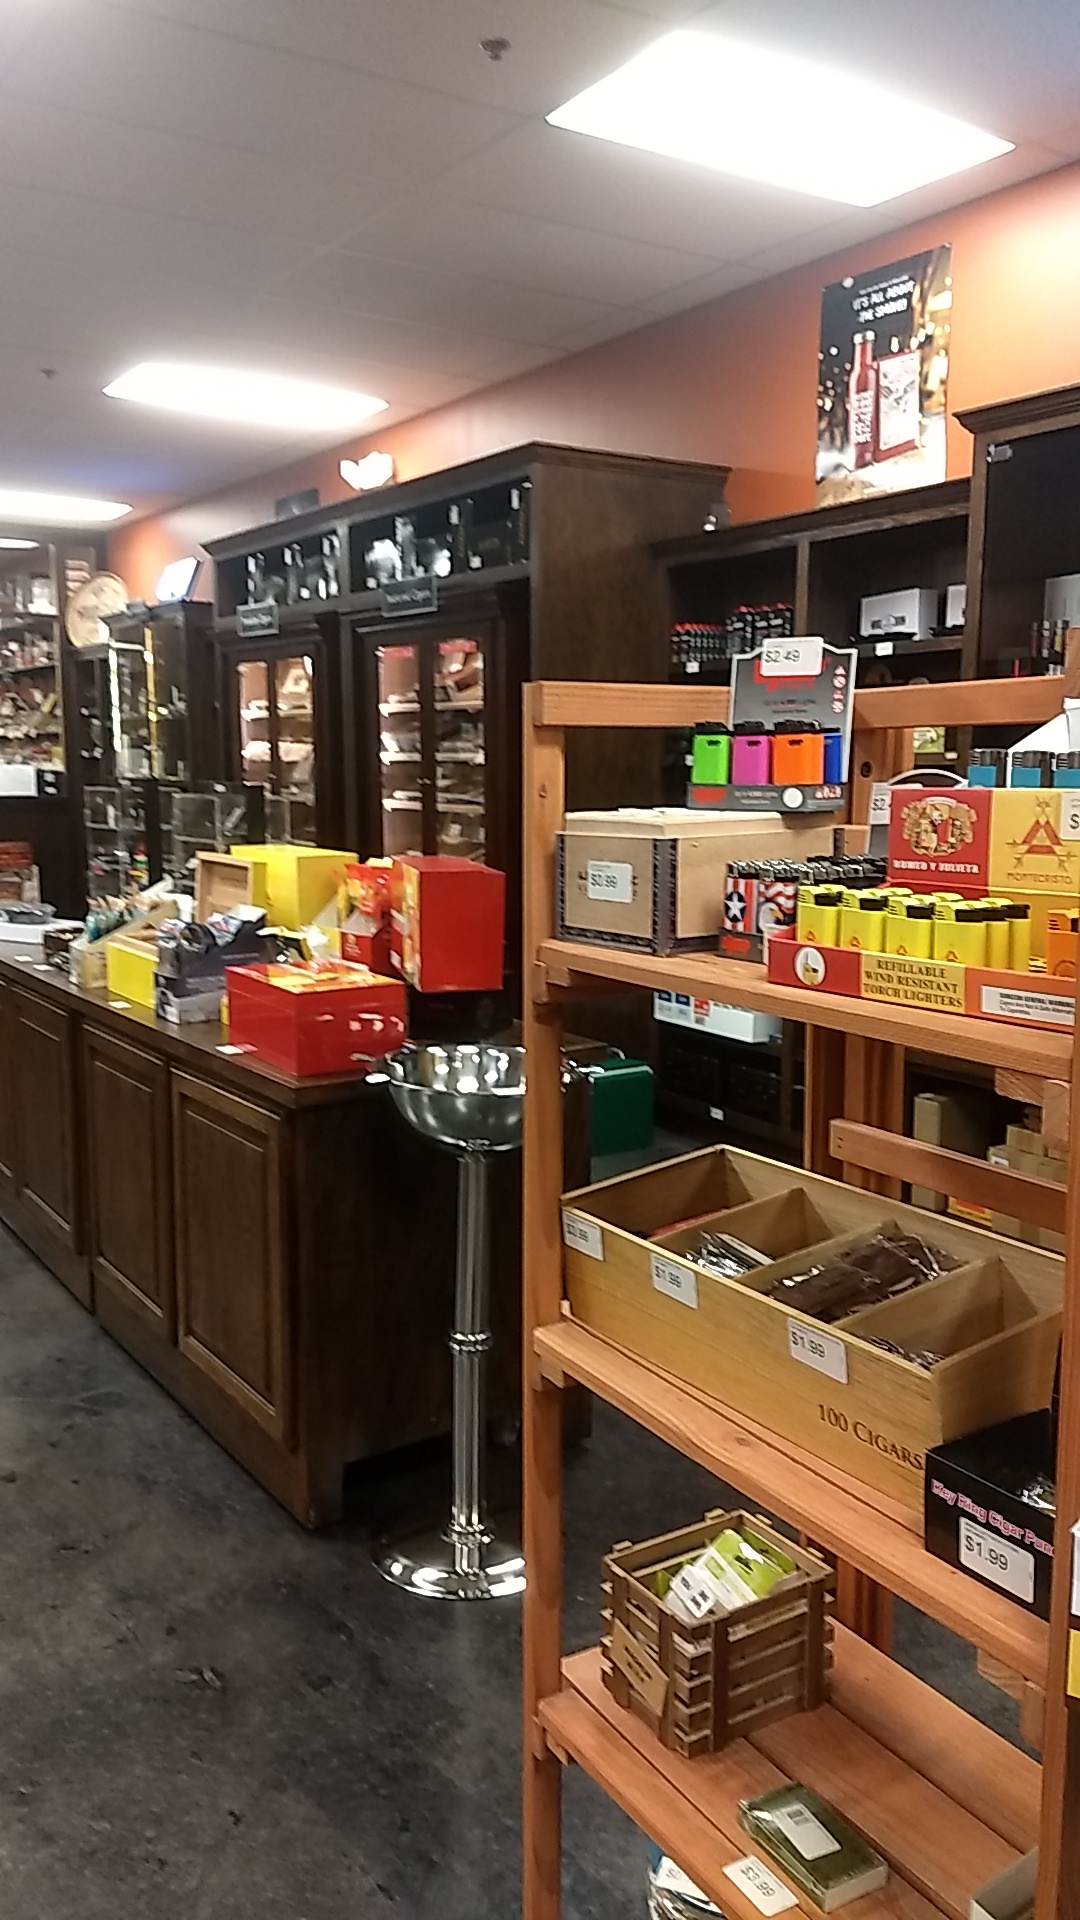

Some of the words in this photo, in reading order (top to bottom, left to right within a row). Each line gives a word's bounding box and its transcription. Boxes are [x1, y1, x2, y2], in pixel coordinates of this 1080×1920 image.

[892, 859, 928, 871] ROMEO
[930, 862, 937, 871] Y
[938, 862, 980, 874] JULIETA
[1007, 872, 1072, 885] MONTECRISTO
[876, 959, 946, 979] REFILLABLE
[864, 970, 894, 985] WIND
[897, 975, 959, 995] RESISTANT
[863, 983, 901, 998] TORCH
[903, 990, 964, 1009] LIGHTERS
[791, 1331, 826, 1359] $1.99
[818, 1404, 849, 1433] 100
[853, 1421, 924, 1471] CIGARS
[931, 1479, 957, 1505] Key
[957, 1492, 988, 1523] Ring
[988, 1510, 1024, 1540] Cigar
[964, 1535, 1009, 1571] $1.99
